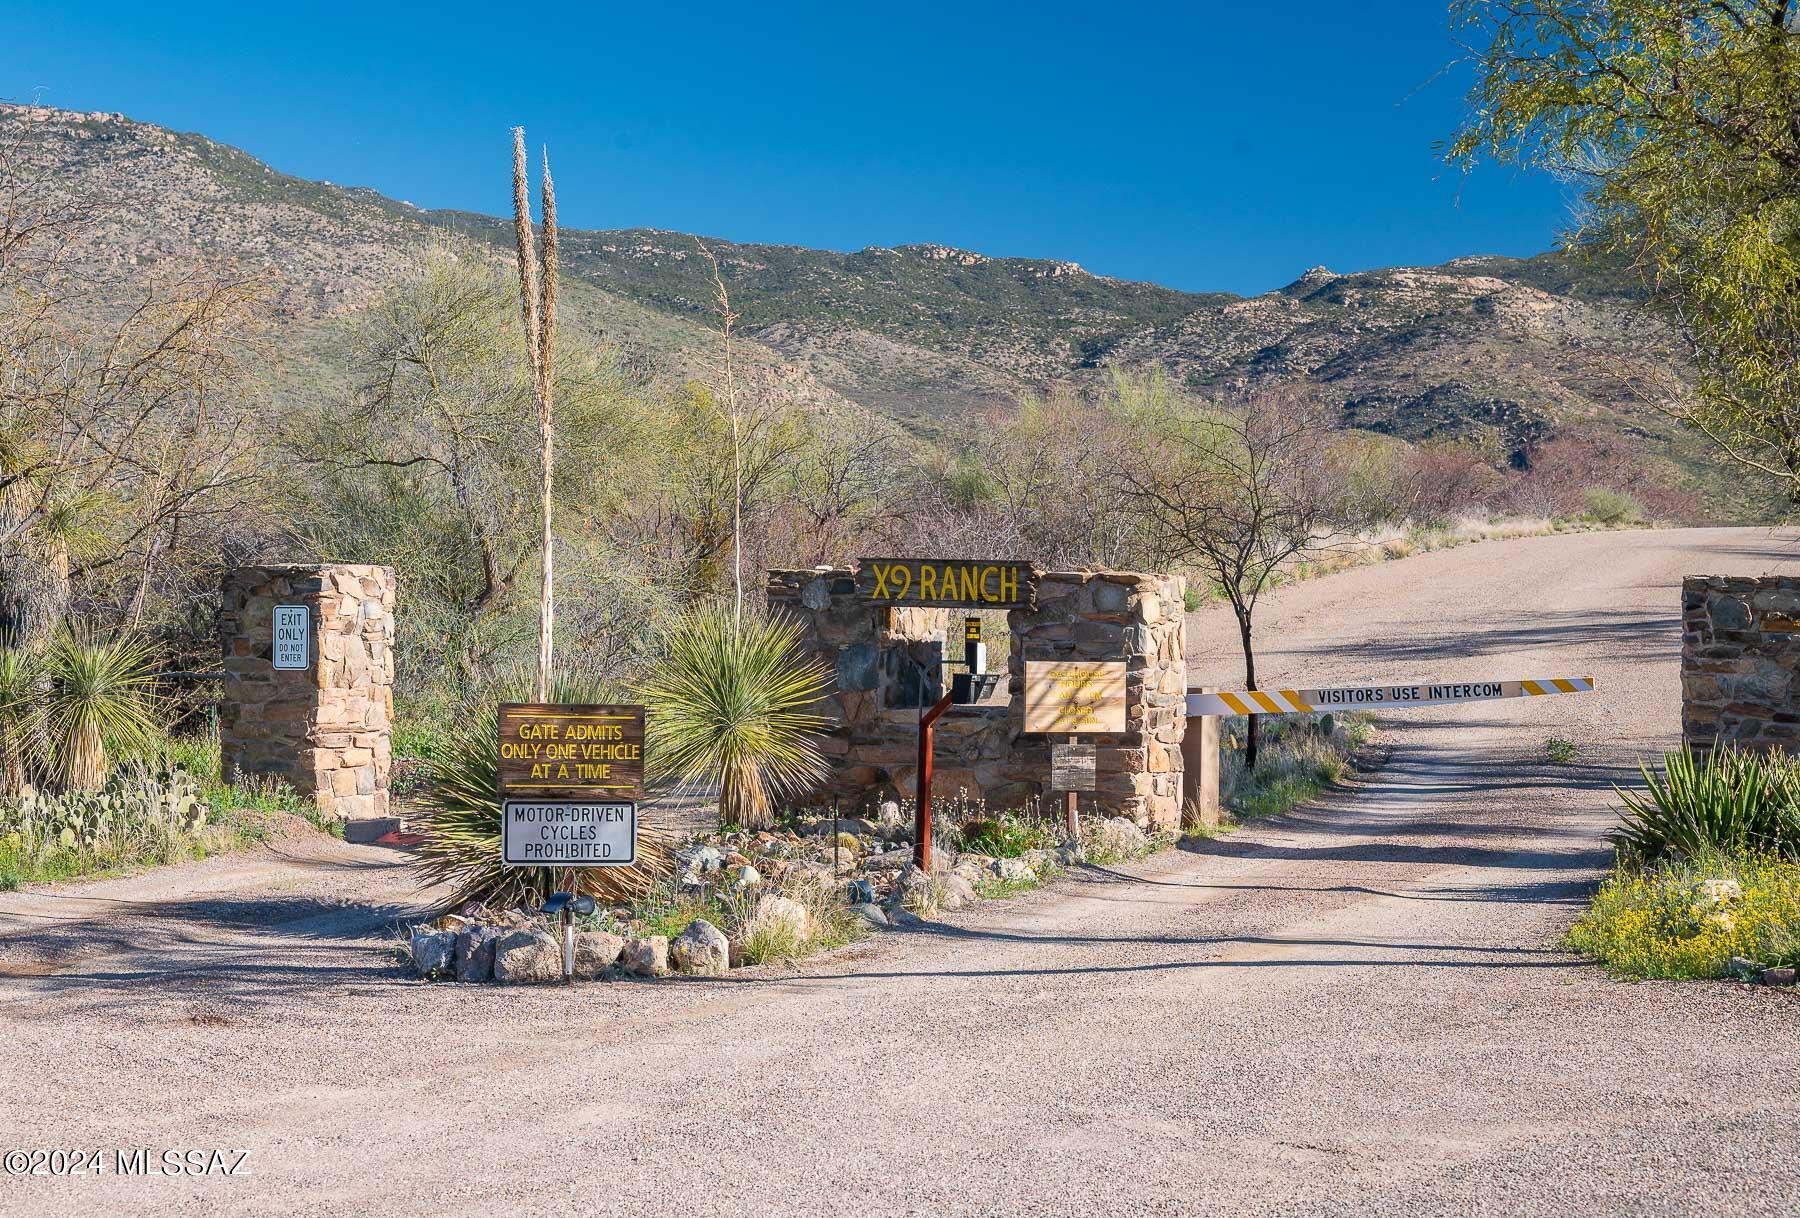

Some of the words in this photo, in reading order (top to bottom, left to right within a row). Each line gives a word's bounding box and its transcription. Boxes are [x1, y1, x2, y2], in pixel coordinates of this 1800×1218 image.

[872, 564, 911, 600] X9
[920, 565, 1017, 602] RANCH
[281, 614, 302, 626] EXIT
[278, 628, 304, 640] ONLY
[279, 643, 289, 652] DO
[290, 643, 303, 652] NOT
[280, 653, 302, 662] ENTER
[1318, 688, 1384, 704] VISITORS
[1392, 686, 1421, 701] USE
[1428, 683, 1503, 700] INTERCOM
[1059, 705, 1094, 716] CLOSED
[519, 724, 559, 740] GATE
[565, 725, 623, 740] ADMITS
[501, 743, 542, 759] ONLY
[546, 743, 577, 760] ONE
[581, 743, 640, 760] VEHICLE
[530, 763, 551, 779] AT
[557, 763, 569, 779] A
[576, 764, 611, 779] TIME
[514, 807, 625, 823] MOTOR-DRIVEN
[540, 825, 597, 840] CYCLES
[524, 843, 612, 859] PROHIBITED
